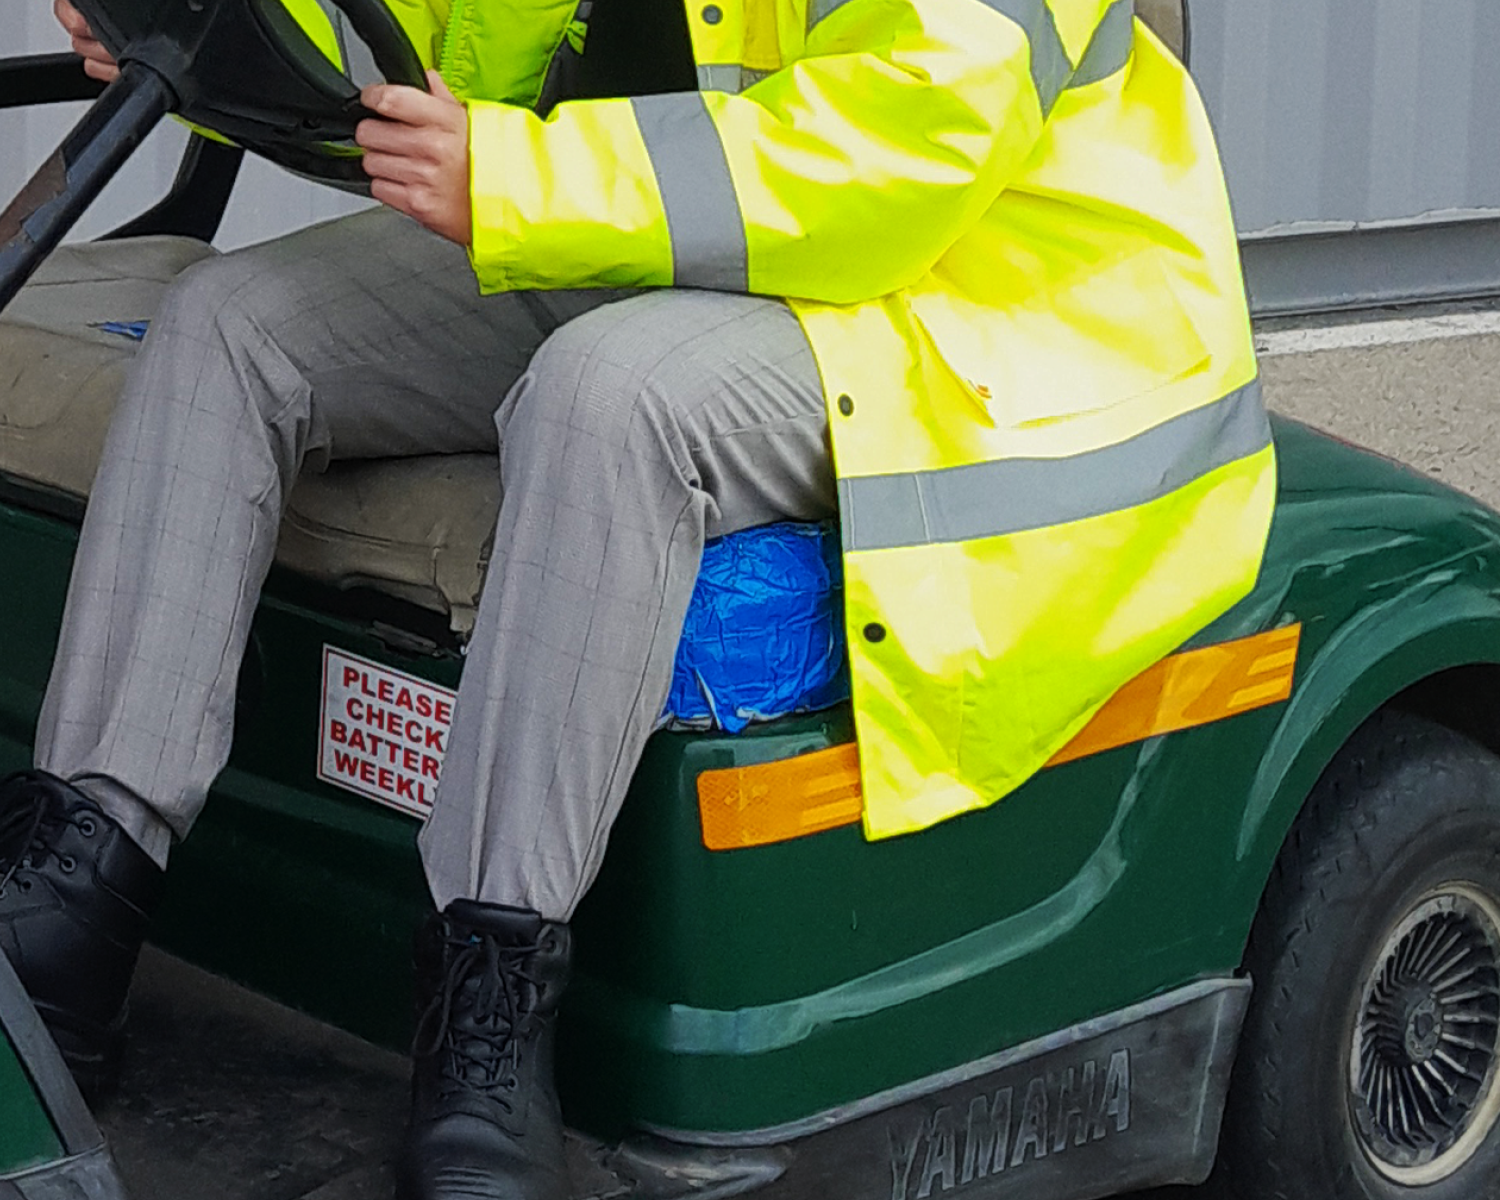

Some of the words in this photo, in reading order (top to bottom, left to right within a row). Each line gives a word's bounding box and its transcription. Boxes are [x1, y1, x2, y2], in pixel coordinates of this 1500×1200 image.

[343, 665, 452, 725] PLEASE
[346, 697, 445, 753] CHECK
[330, 719, 441, 780] BATTER
[333, 748, 437, 808] WEEKL
[886, 1048, 1131, 1200] YAMAHA
